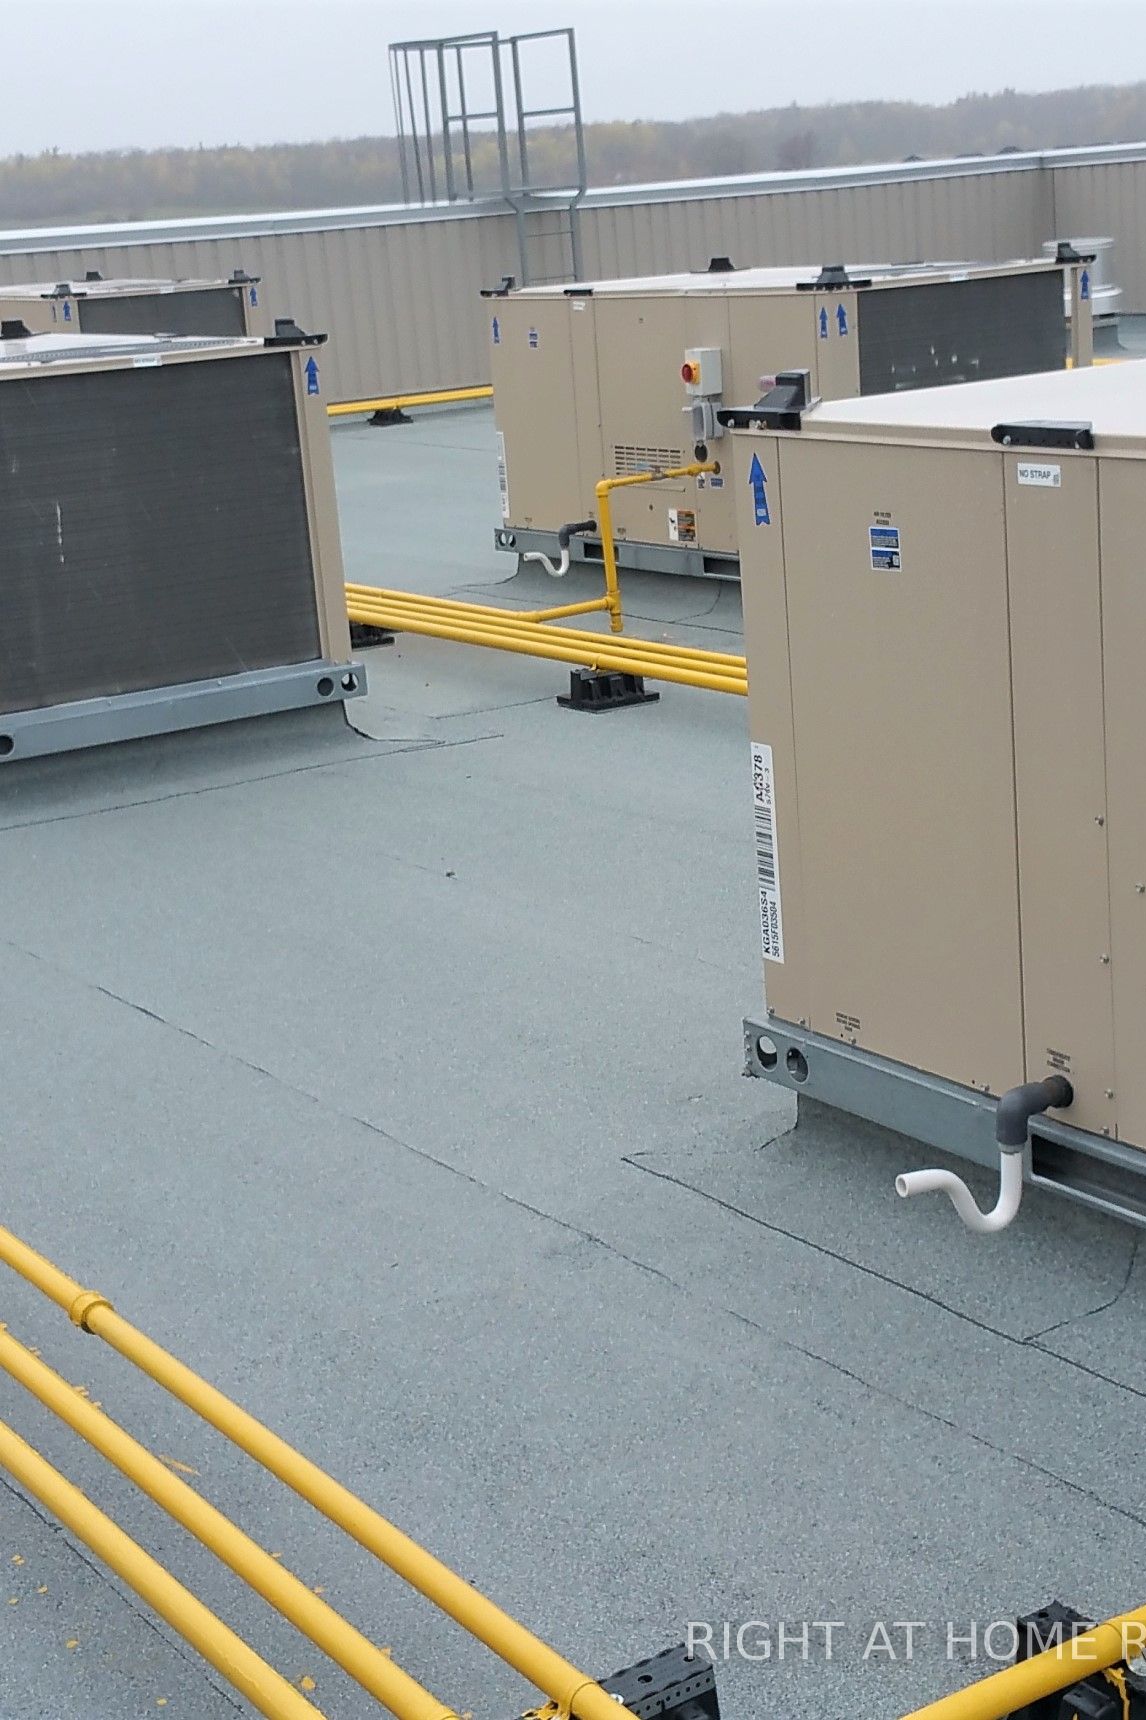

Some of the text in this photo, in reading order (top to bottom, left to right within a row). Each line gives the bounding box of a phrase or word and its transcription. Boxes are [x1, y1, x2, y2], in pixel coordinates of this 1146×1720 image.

[1019, 469, 1051, 479] NO STRAP
[760, 890, 771, 954] KGA036S4
